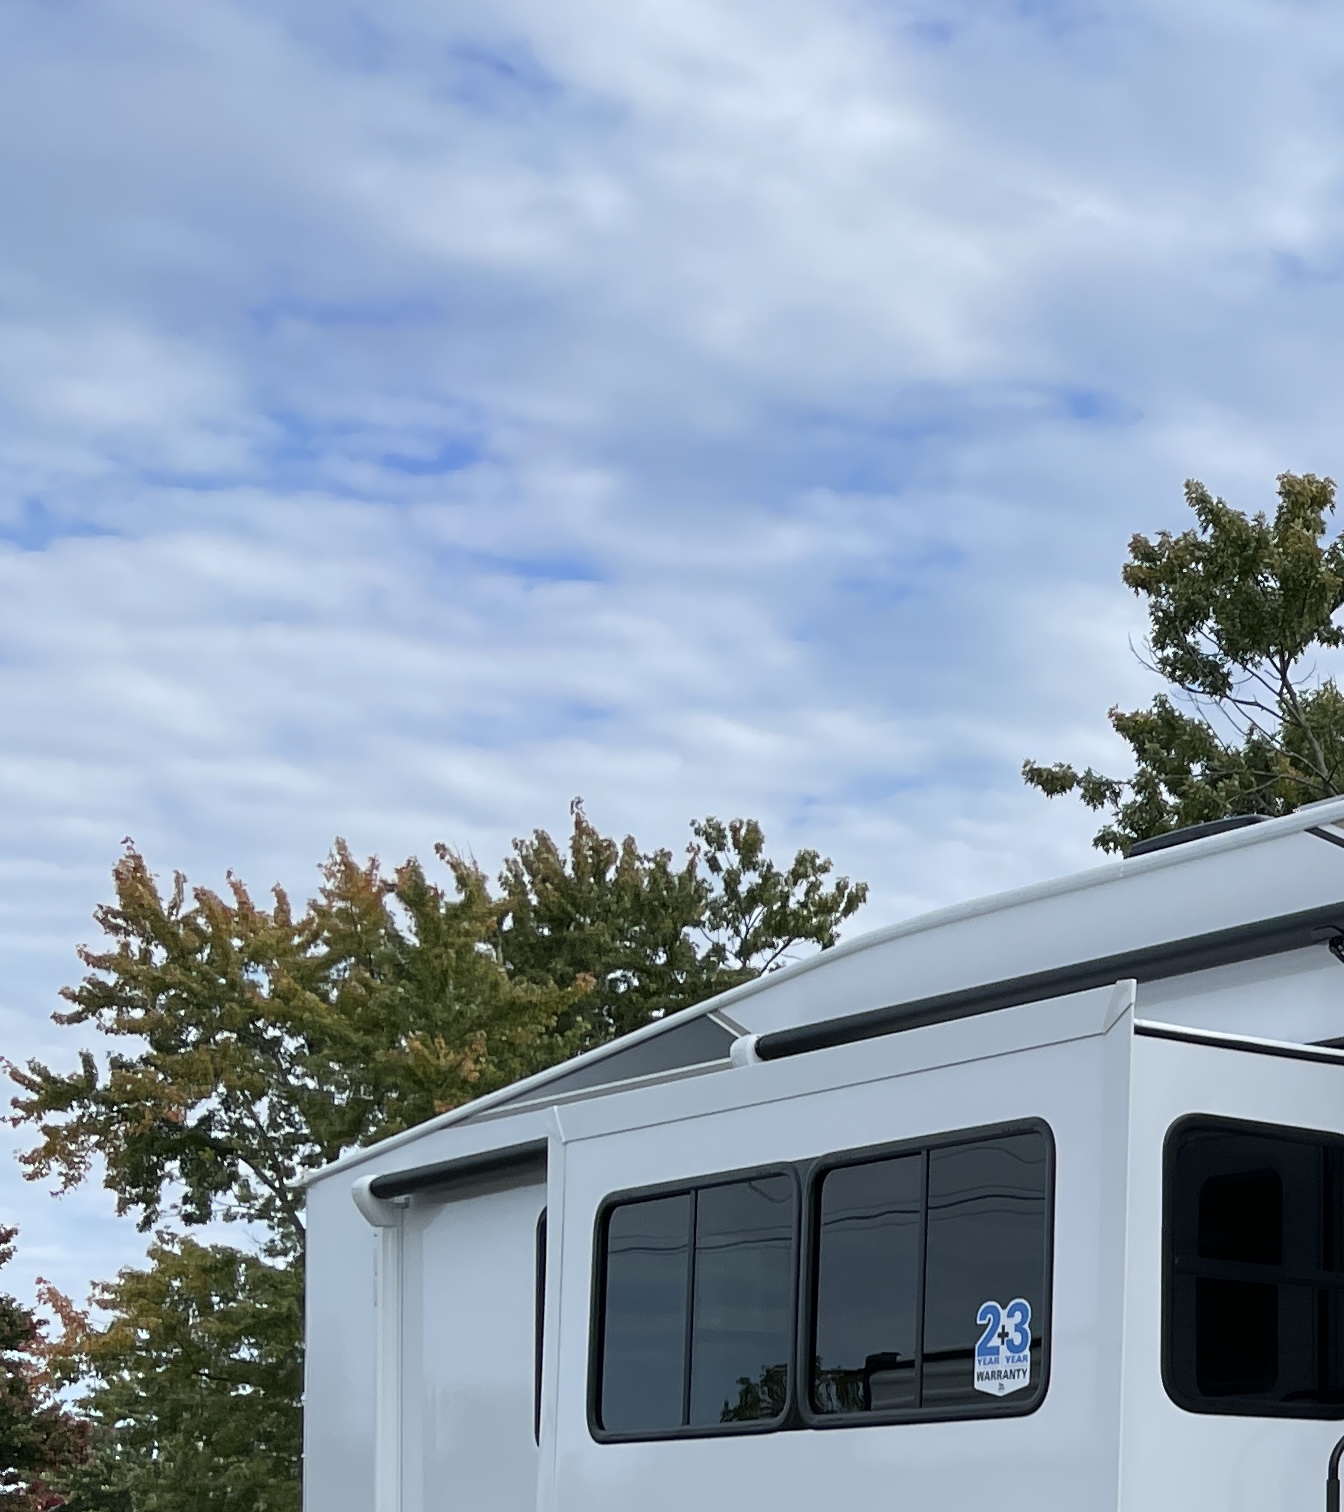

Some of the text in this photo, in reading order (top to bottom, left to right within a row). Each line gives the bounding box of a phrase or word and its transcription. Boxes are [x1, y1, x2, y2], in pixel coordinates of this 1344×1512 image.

[978, 1354, 1028, 1366] YEAR YEAR
[976, 1368, 1028, 1382] WARRANTY
